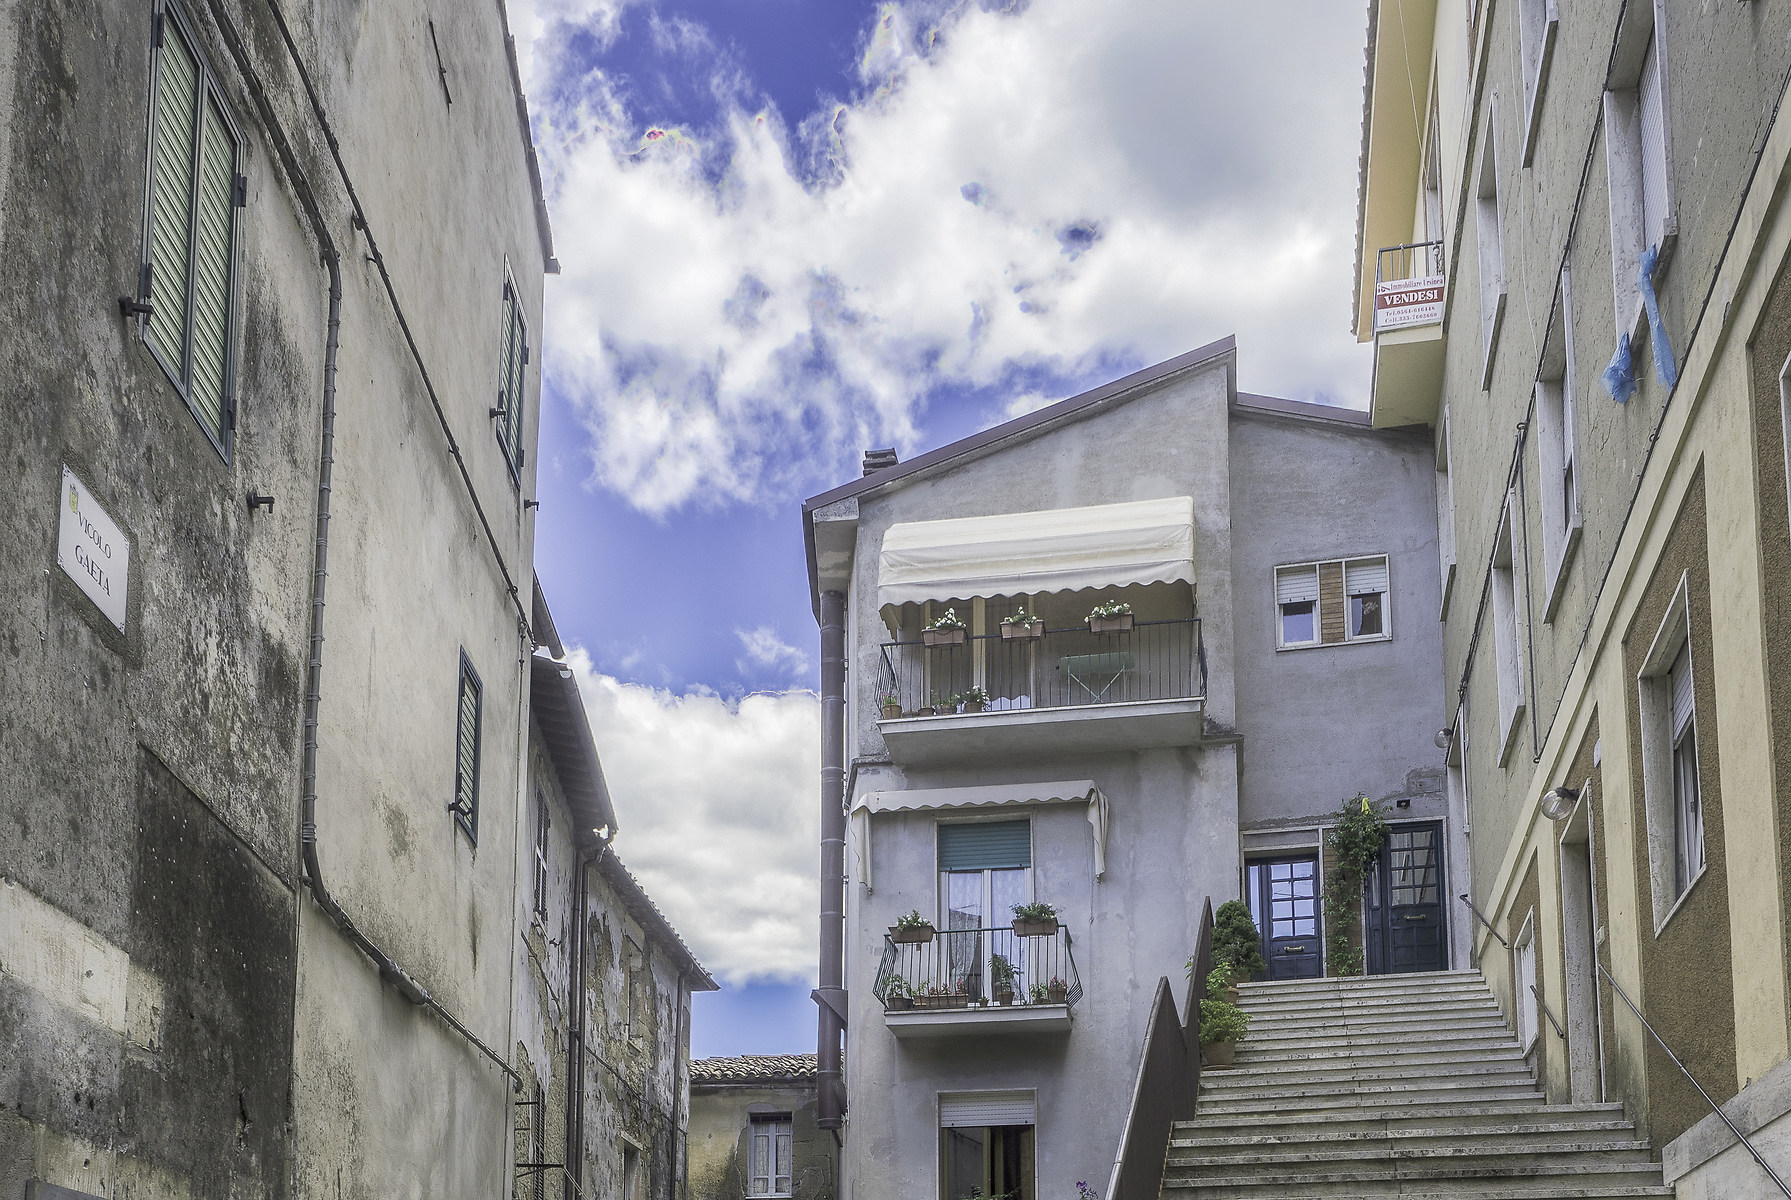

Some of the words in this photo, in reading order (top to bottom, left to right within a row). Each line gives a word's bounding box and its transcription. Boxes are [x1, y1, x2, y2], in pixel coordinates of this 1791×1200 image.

[1384, 290, 1438, 306] VENDESI
[78, 511, 112, 559] VICOLO
[75, 544, 111, 597] GAETA
